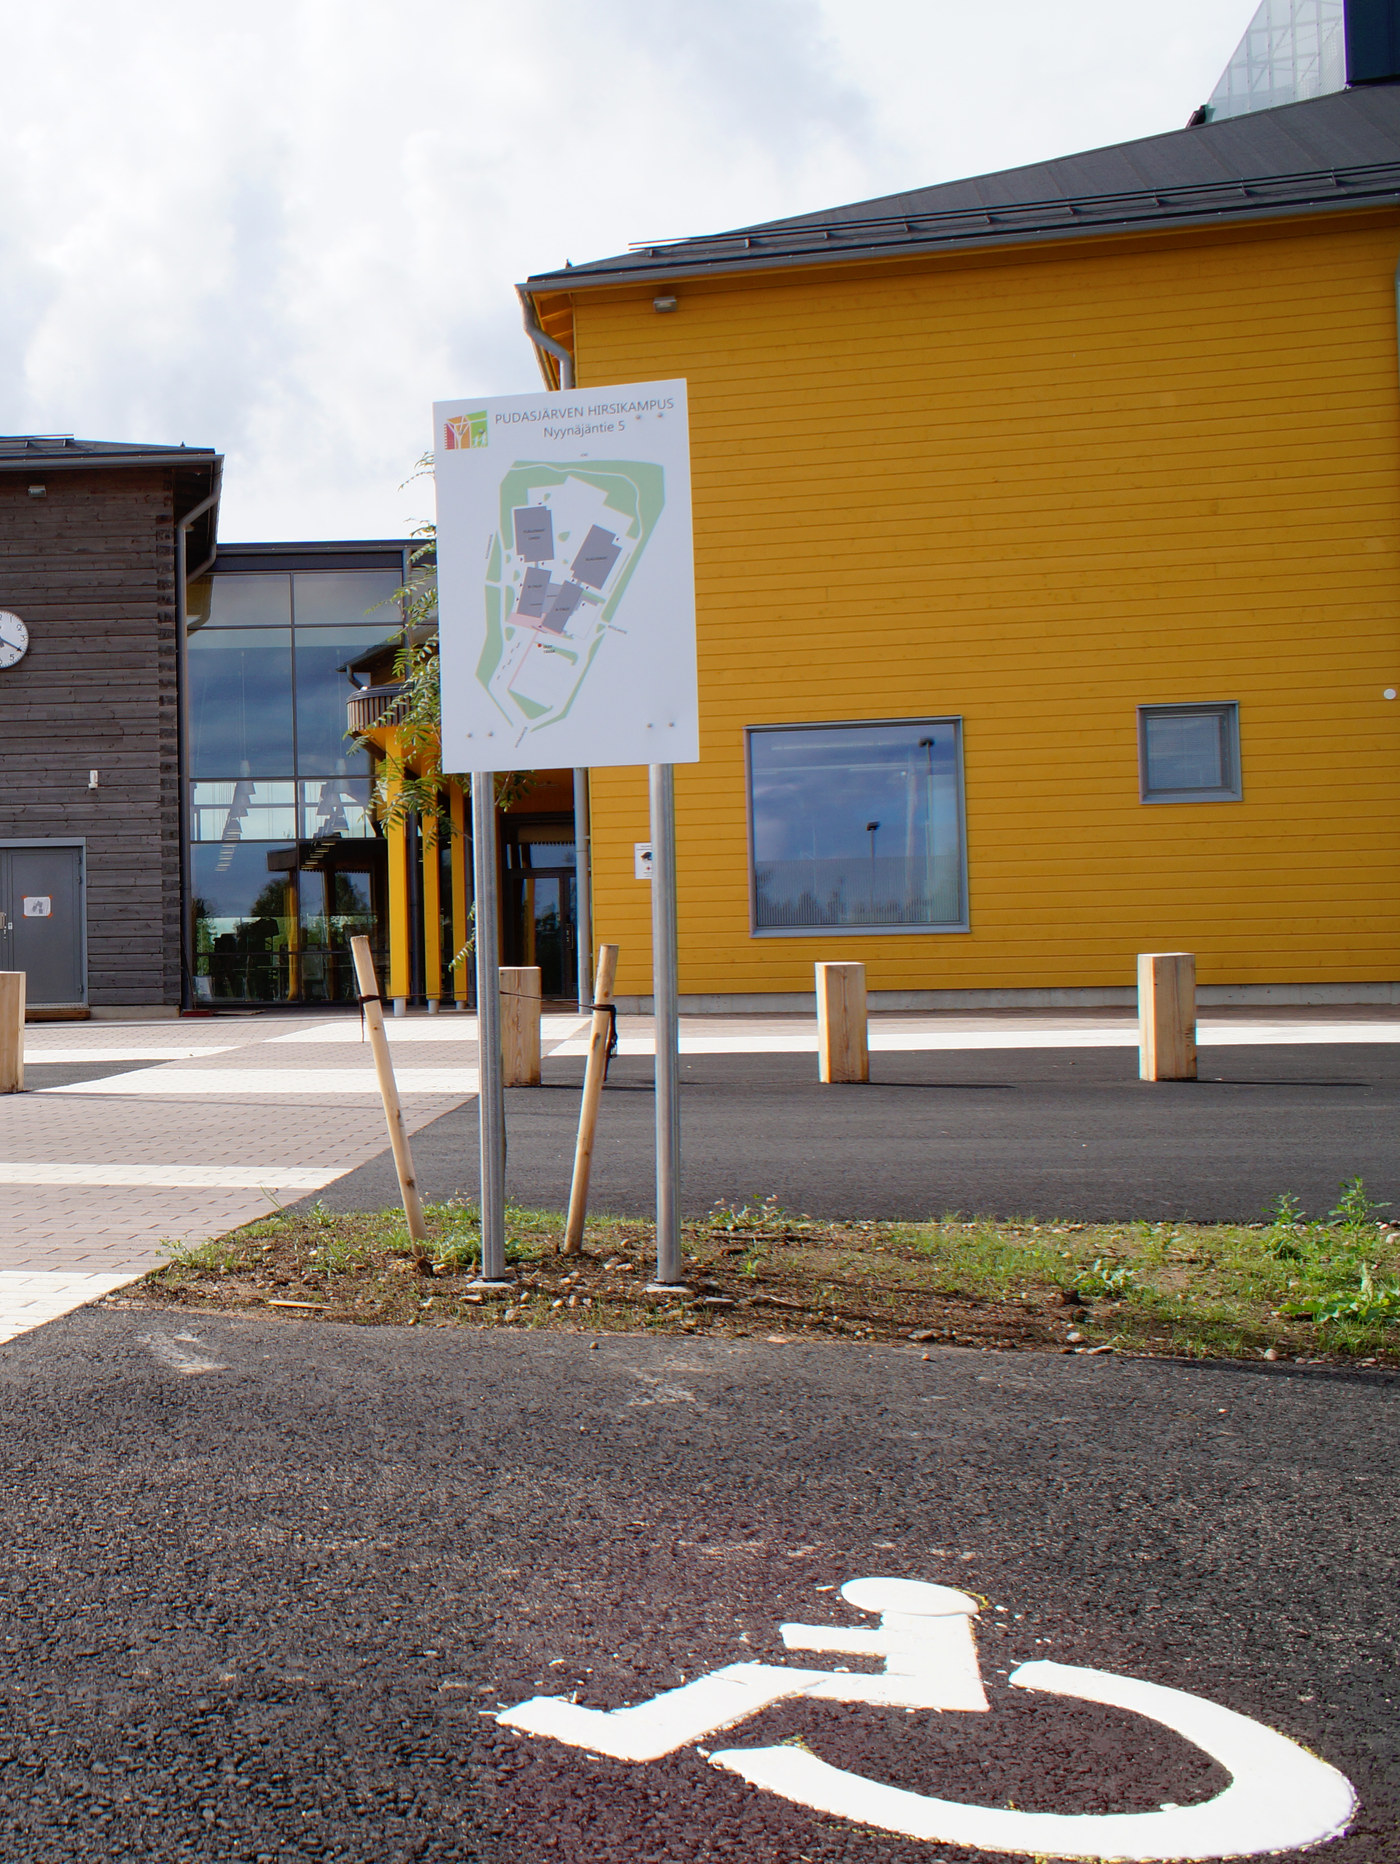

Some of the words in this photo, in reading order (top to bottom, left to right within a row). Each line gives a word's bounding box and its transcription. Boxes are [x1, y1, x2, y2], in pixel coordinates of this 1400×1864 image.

[495, 407, 584, 425] PUDASJÄRVEN
[588, 397, 675, 417] HIRSIKAMPUS
[543, 423, 615, 440] Nyynäjäntie
[617, 420, 625, 432] 5
[20, 634, 25, 642] 3
[9, 653, 15, 661] 5
